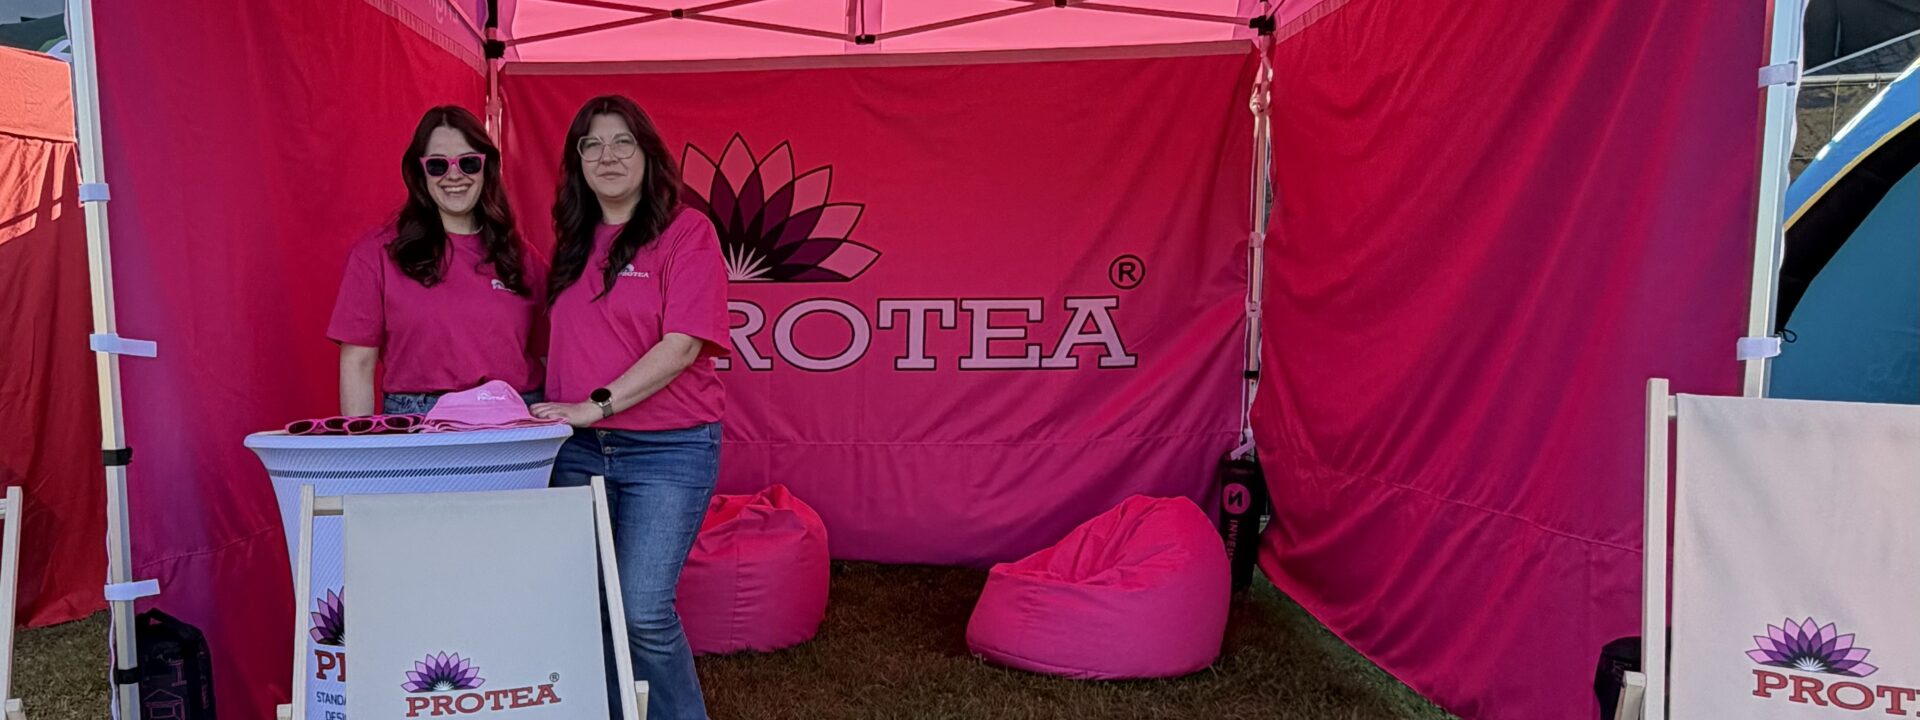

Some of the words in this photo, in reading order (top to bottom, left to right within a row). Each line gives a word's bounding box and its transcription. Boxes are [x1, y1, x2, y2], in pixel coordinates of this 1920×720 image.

[715, 296, 1138, 372] ROTEA
[405, 683, 562, 717] PROTEA
[1752, 669, 1920, 717] PROT
[325, 710, 347, 720] DESI
